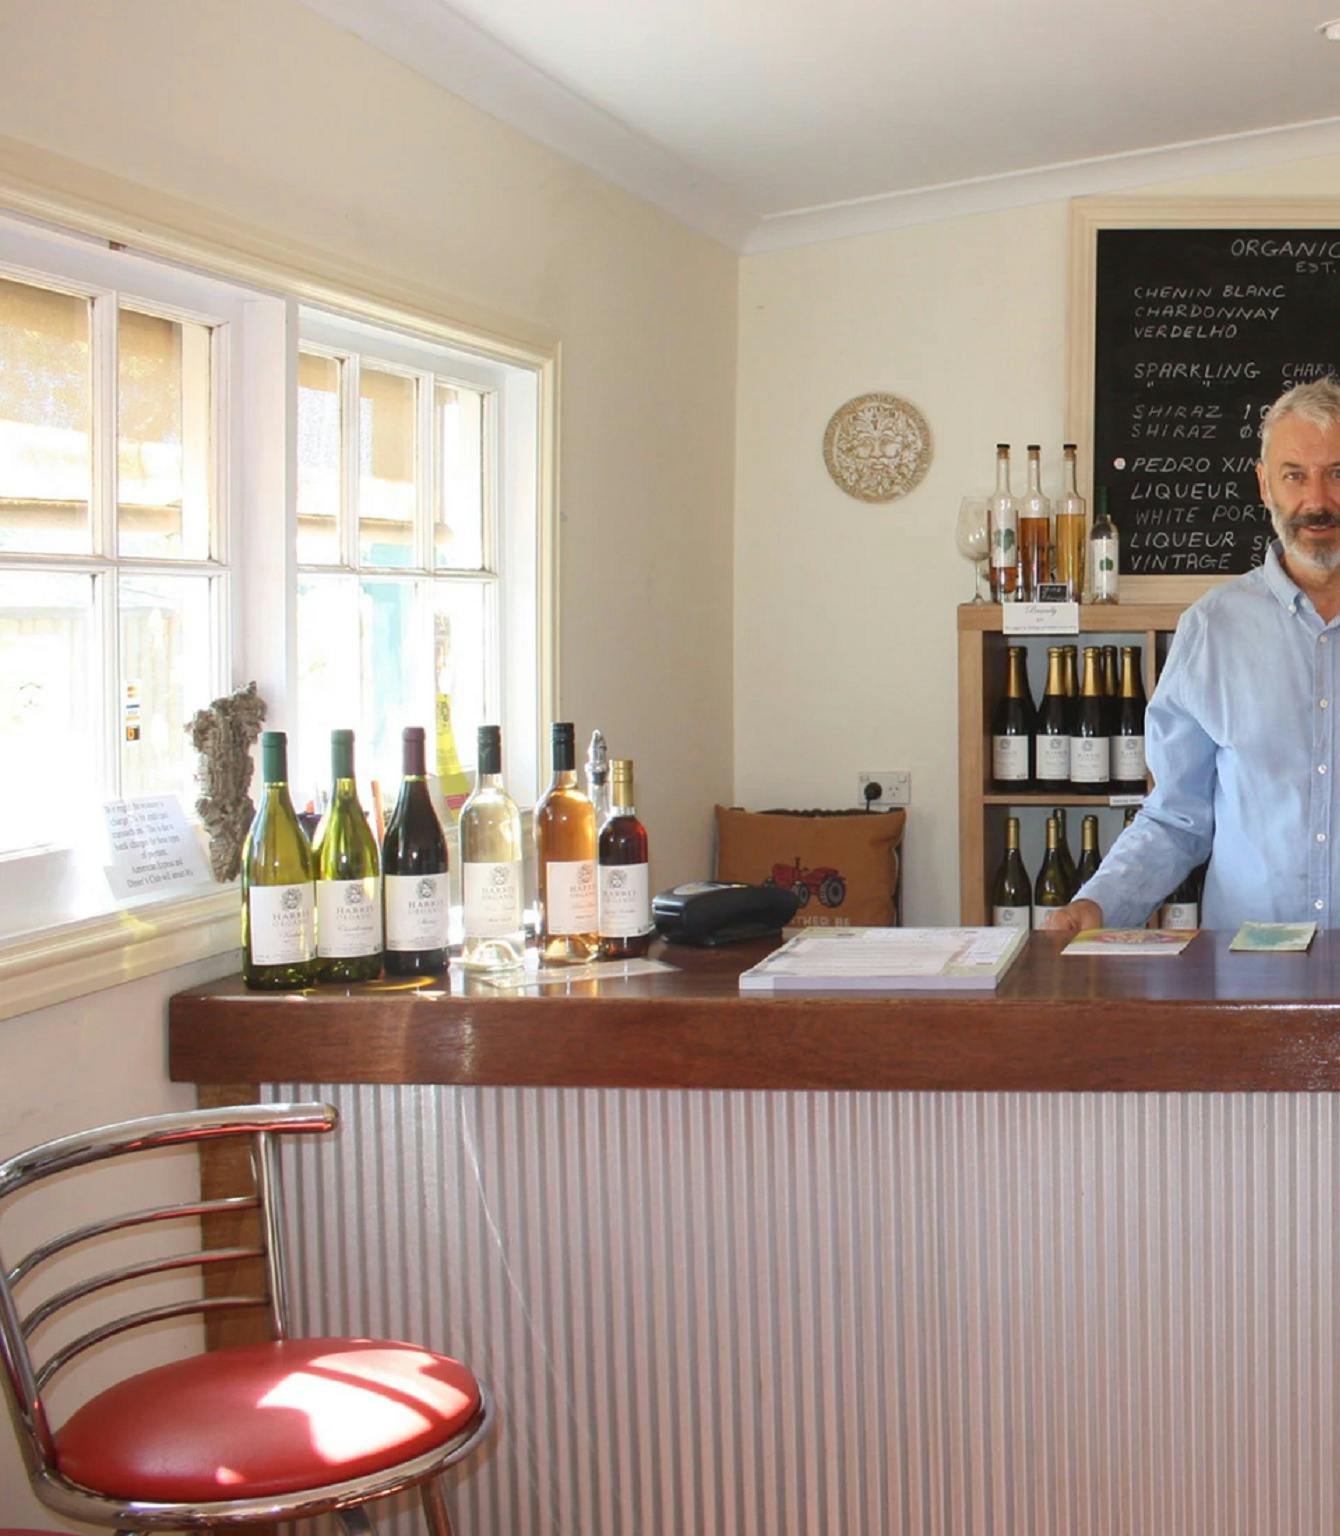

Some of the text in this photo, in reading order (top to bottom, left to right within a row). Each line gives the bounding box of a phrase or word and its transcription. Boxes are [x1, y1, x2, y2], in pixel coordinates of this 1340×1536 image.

[1296, 261, 1336, 274] EST.
[1134, 286, 1212, 299] CHENIN
[1222, 284, 1286, 299] BLANC
[1134, 304, 1281, 321] CHARDONNAY
[1134, 324, 1238, 339] VERDELHO
[1134, 362, 1261, 379] SPARKLING
[1132, 404, 1223, 419] SHIRAZ
[1131, 424, 1217, 439] SHIRAZ
[1131, 457, 1210, 472] PEDRO
[1130, 482, 1240, 500] LIQUEUR
[1135, 508, 1200, 525] WHITE
[1212, 504, 1267, 523] PORT
[1129, 531, 1237, 549] LIQUEUR
[1130, 553, 1232, 571] VINTAGE
